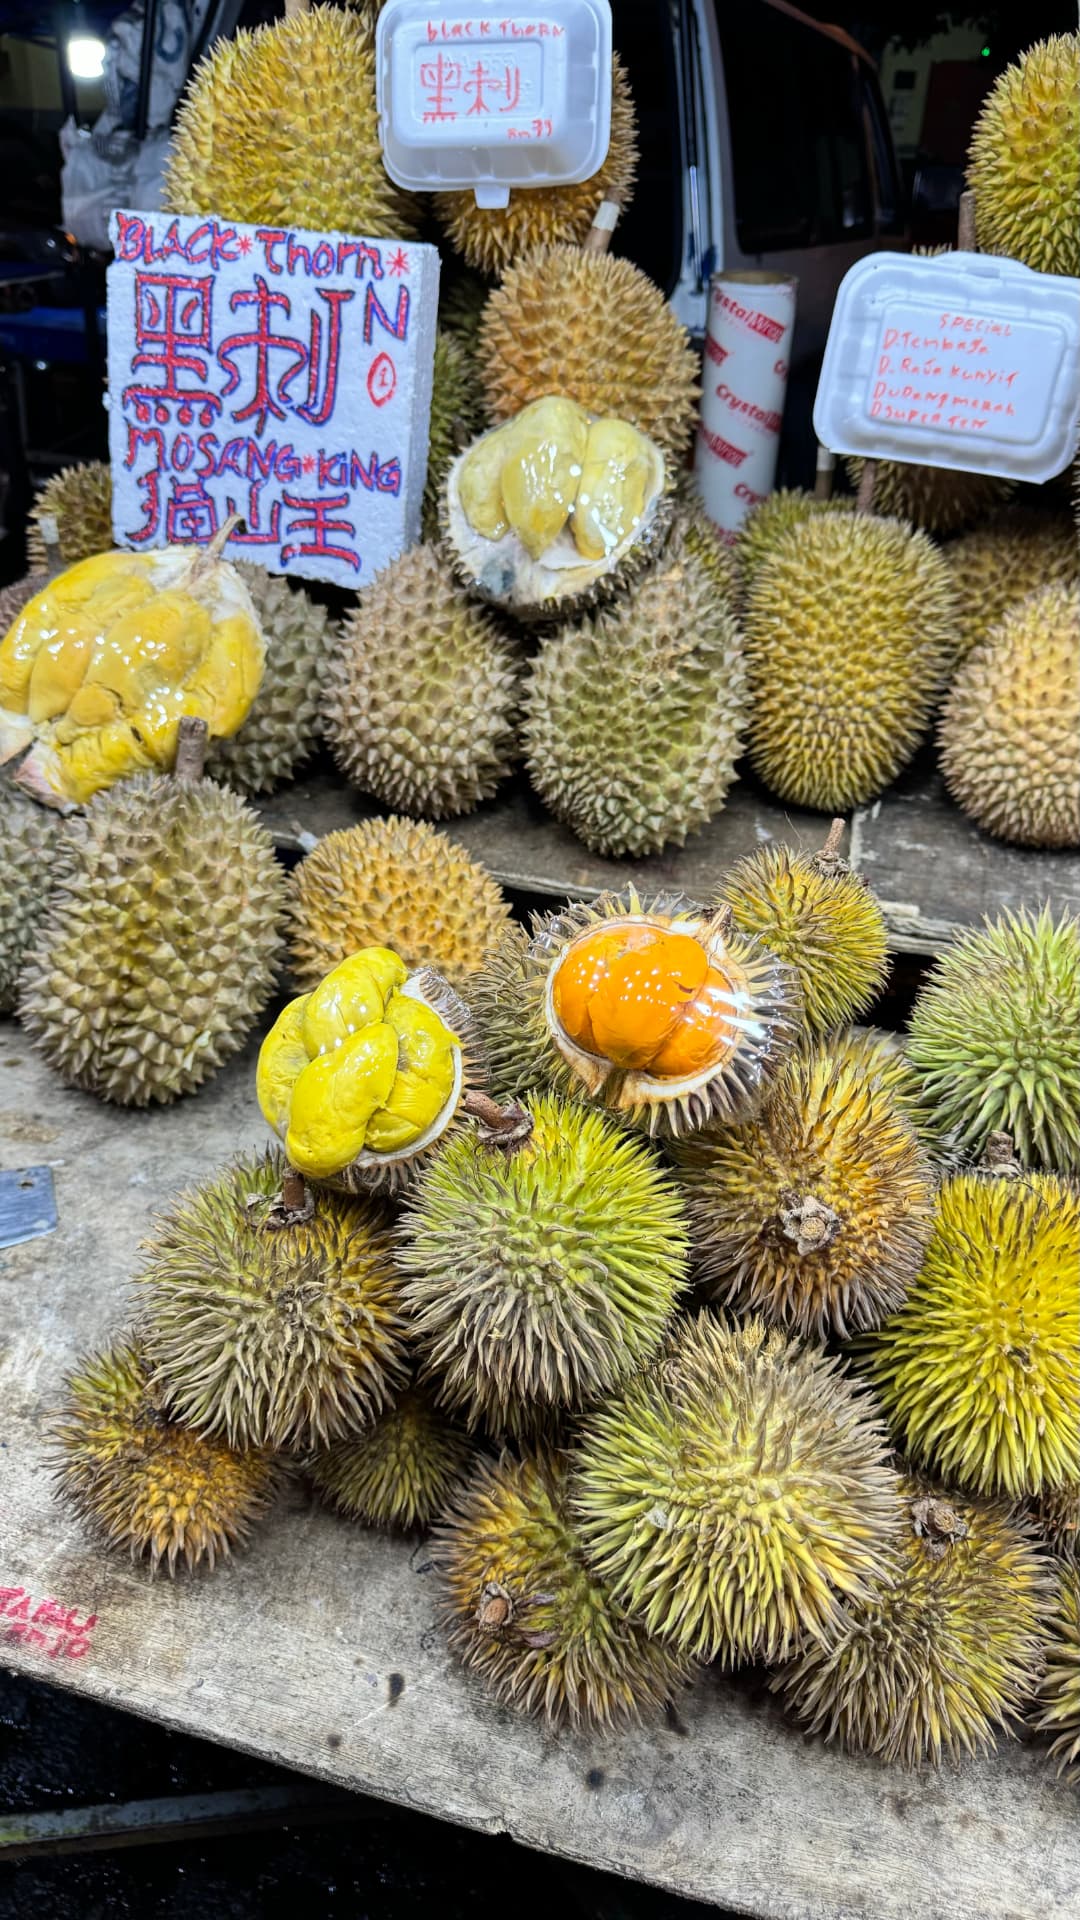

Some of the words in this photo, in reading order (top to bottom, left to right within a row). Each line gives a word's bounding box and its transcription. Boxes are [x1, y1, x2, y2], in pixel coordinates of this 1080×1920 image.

[420, 52, 521, 123] 黑刺
[256, 229, 385, 280] Thorn
[364, 281, 410, 345] N
[122, 269, 356, 437] 黑刺
